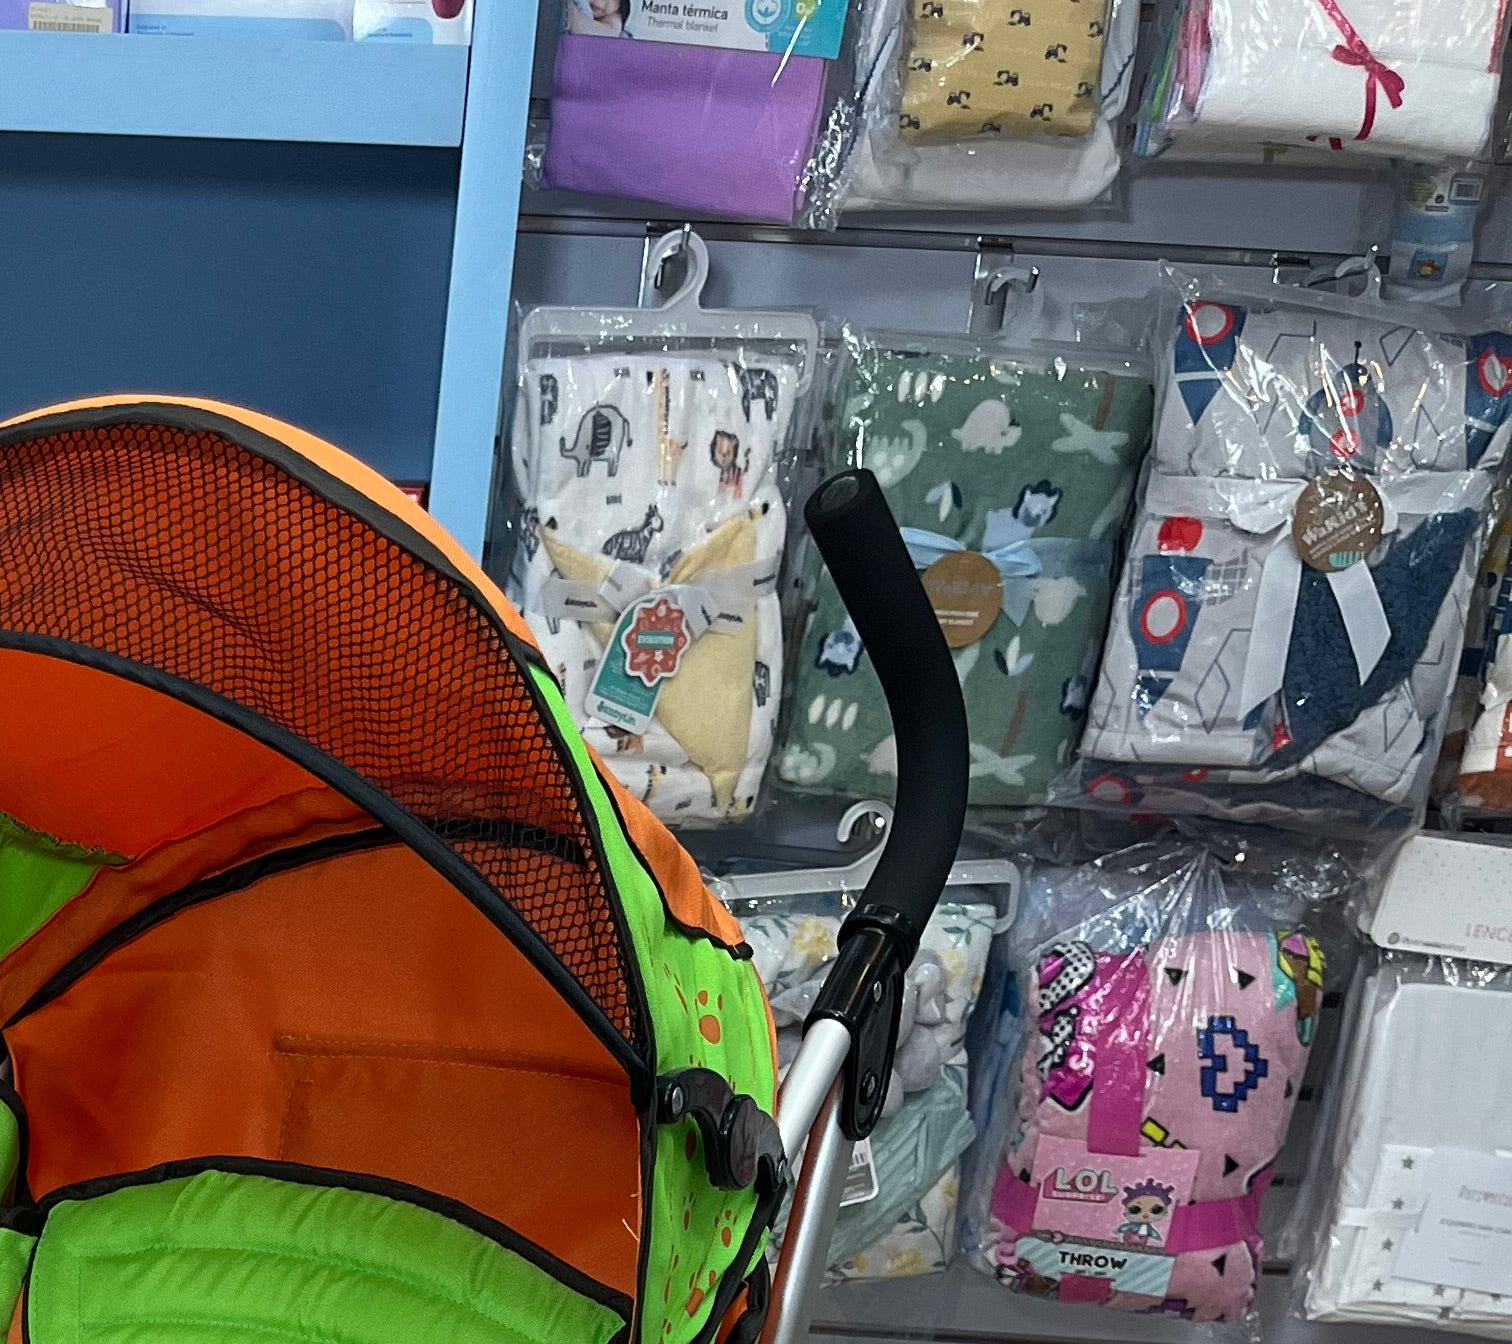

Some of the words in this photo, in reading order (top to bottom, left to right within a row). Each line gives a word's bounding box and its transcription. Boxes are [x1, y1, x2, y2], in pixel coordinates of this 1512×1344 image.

[641, 1, 679, 16] Manta
[683, 2, 728, 20] térmica
[1054, 1167, 1120, 1194] LOL
[1058, 1250, 1128, 1270] THROW
